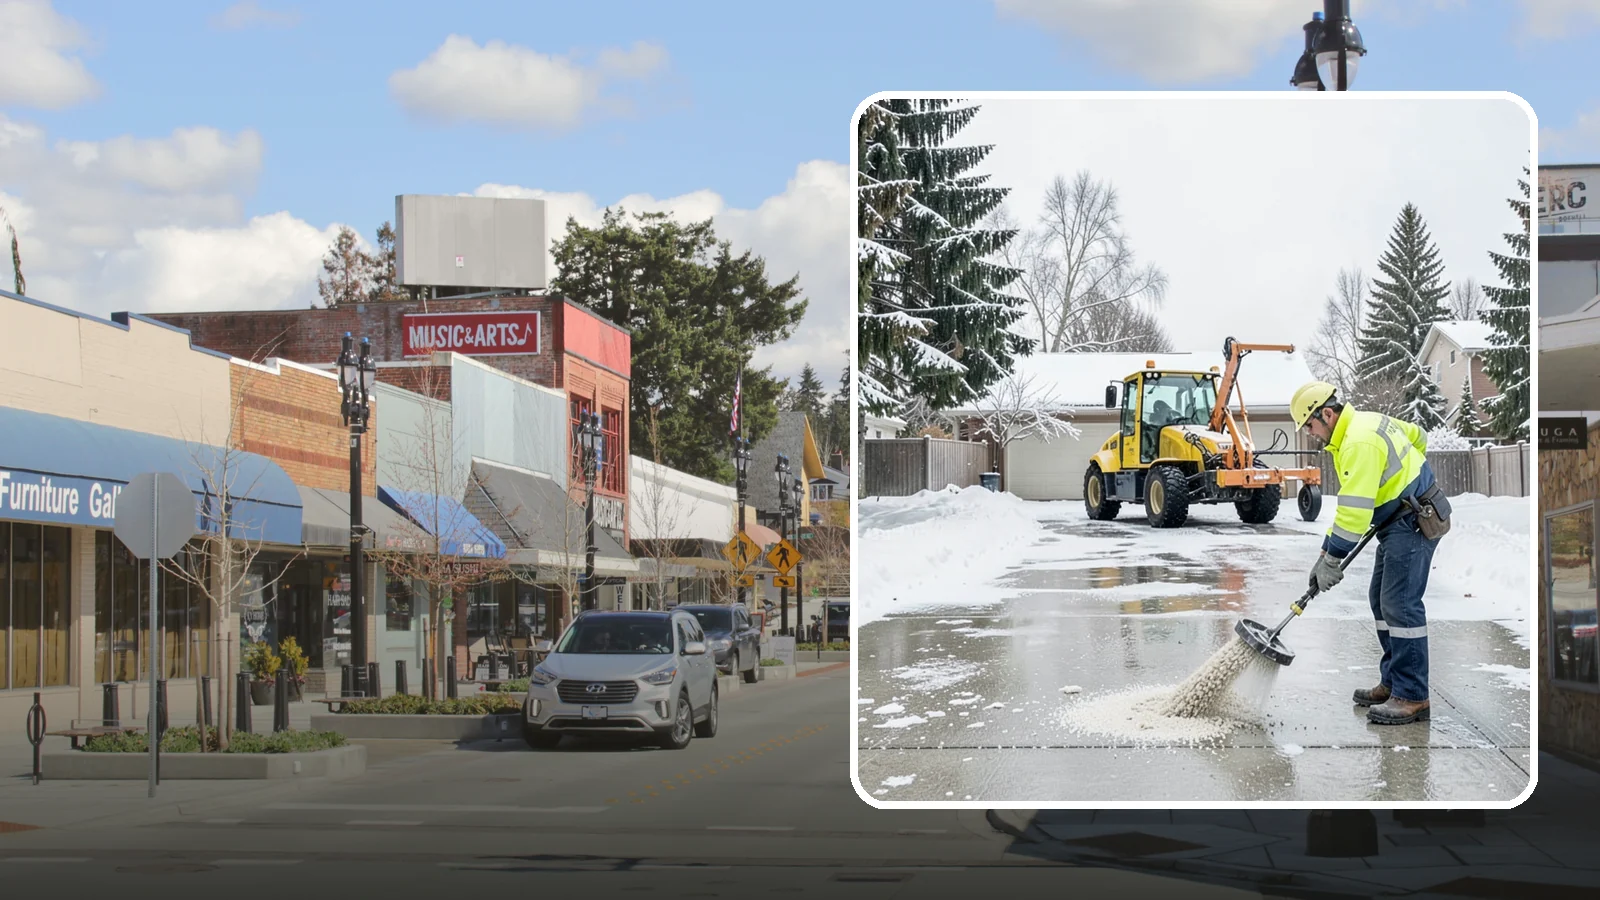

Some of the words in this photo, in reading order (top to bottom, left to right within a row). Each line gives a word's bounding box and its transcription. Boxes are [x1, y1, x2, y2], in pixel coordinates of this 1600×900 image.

[409, 323, 520, 349] MUSIC&ARTS
[0, 471, 79, 515] Furniture
[89, 482, 122, 518] Gal
